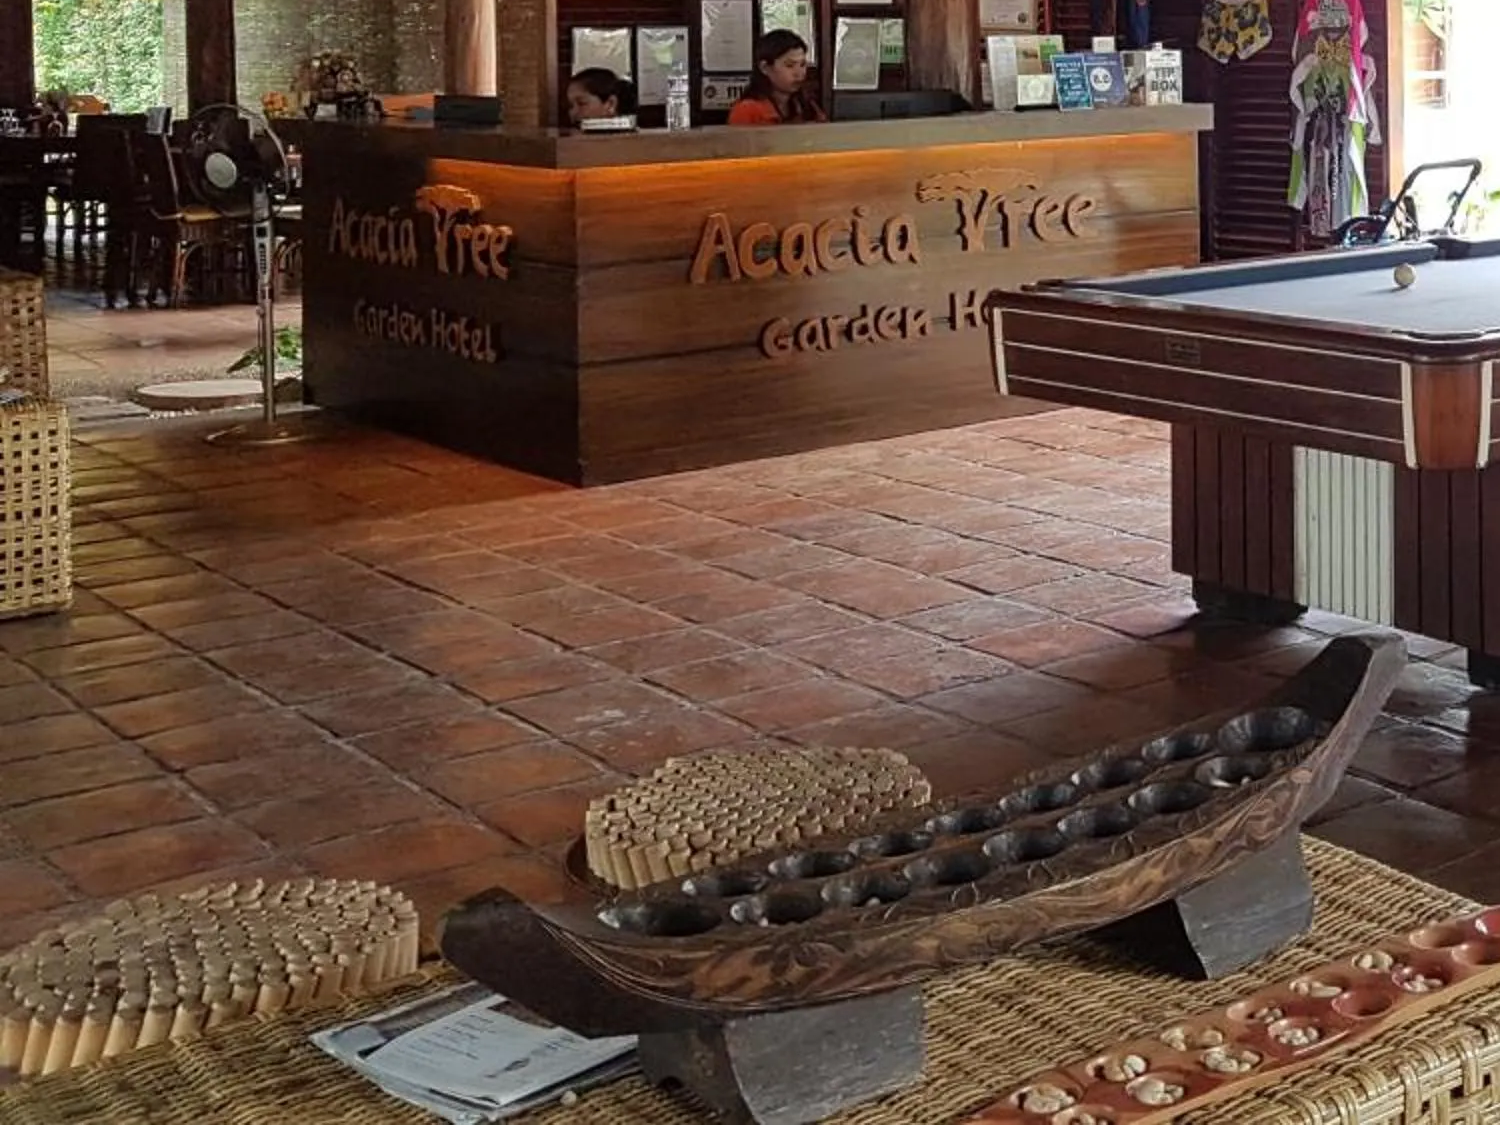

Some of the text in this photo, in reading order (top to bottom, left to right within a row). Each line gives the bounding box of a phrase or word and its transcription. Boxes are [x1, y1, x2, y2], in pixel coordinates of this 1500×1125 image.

[1151, 80, 1178, 92] BOX
[329, 184, 514, 281] Acacia Tree
[689, 167, 1100, 285] Acacia Tree
[354, 297, 498, 365] Garden Hotel
[759, 302, 935, 361] Garden
